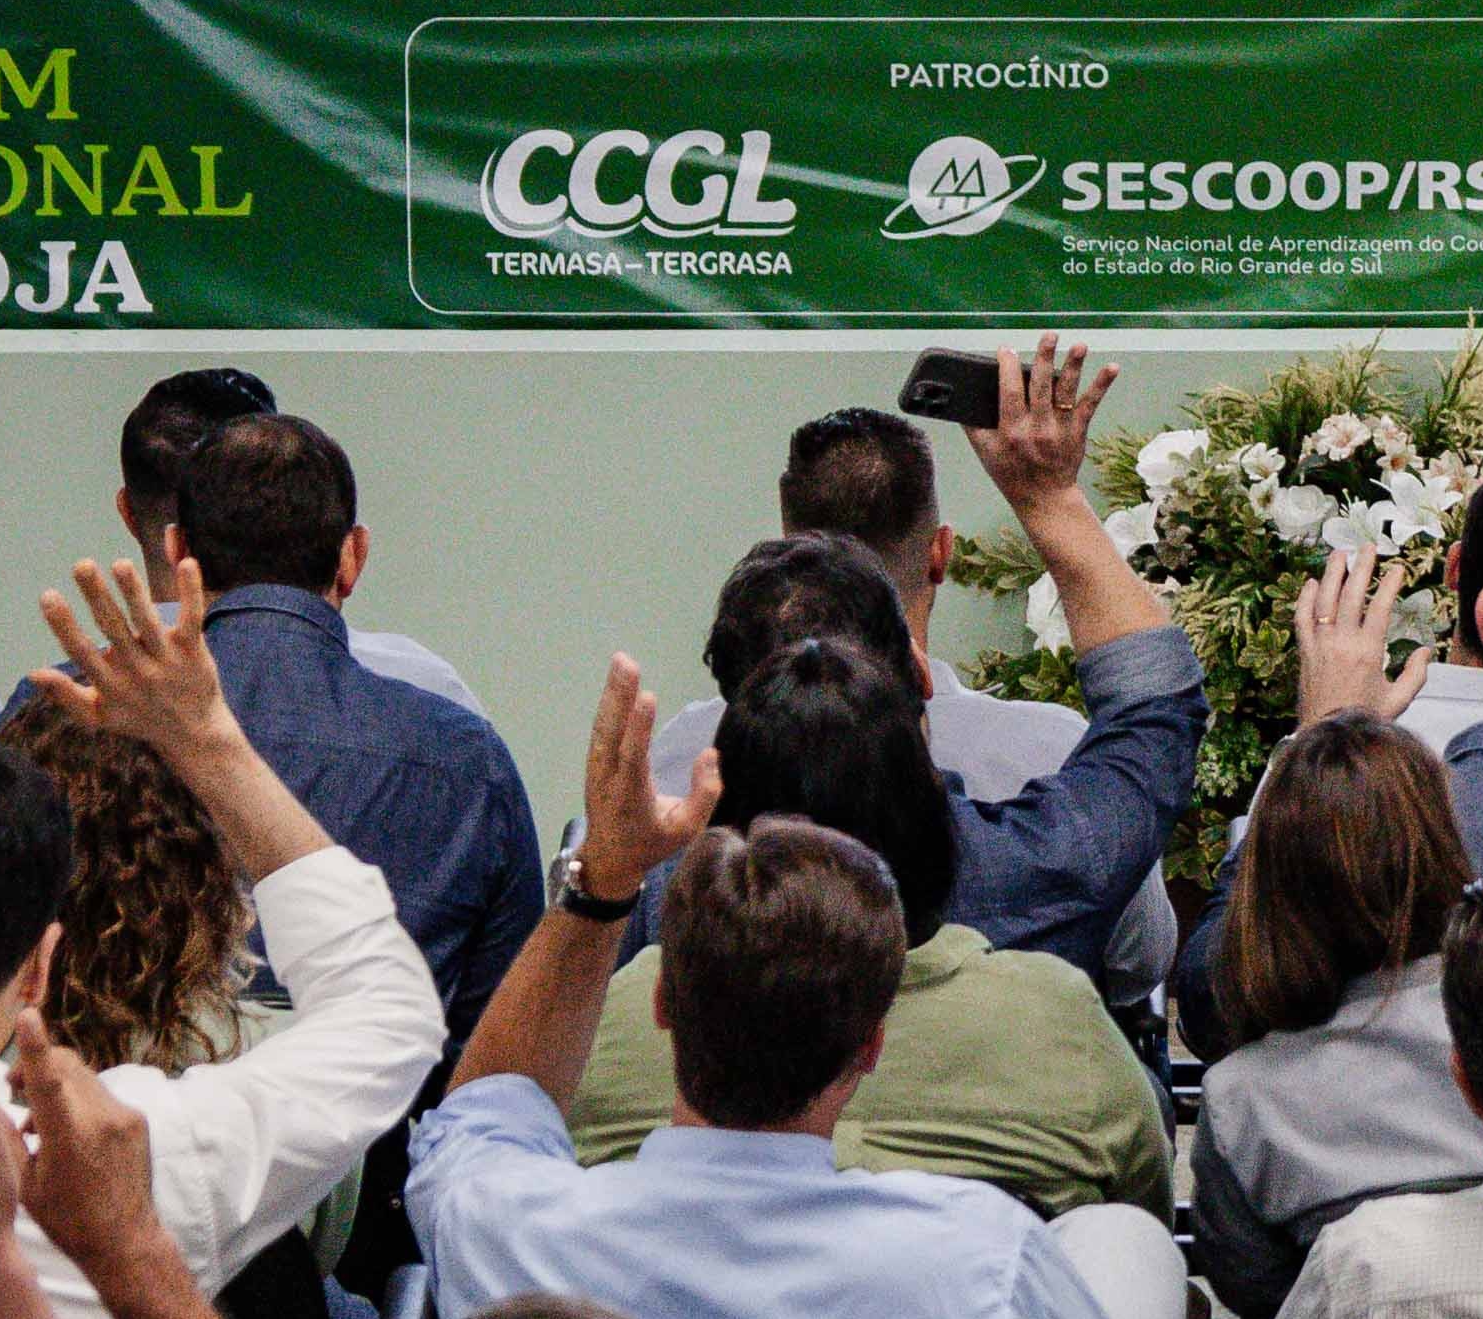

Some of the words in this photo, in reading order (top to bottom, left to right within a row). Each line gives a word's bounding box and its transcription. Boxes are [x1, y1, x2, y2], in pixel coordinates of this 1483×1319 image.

[891, 55, 1108, 88] PATROCÍNIO
[480, 129, 797, 238] CCGL
[1063, 236, 1139, 256] Serviço
[1146, 236, 1234, 252] Nacional
[1239, 236, 1264, 252] de
[1269, 236, 1413, 256] Aprendizagem
[1418, 236, 1444, 252] do
[1062, 257, 1087, 274] do
[1094, 257, 1163, 274] Estado
[1169, 257, 1195, 274] do
[1201, 257, 1229, 274] Rio
[1239, 257, 1313, 274] Grande
[1319, 257, 1345, 274] do
[1351, 257, 1384, 274] Sul
